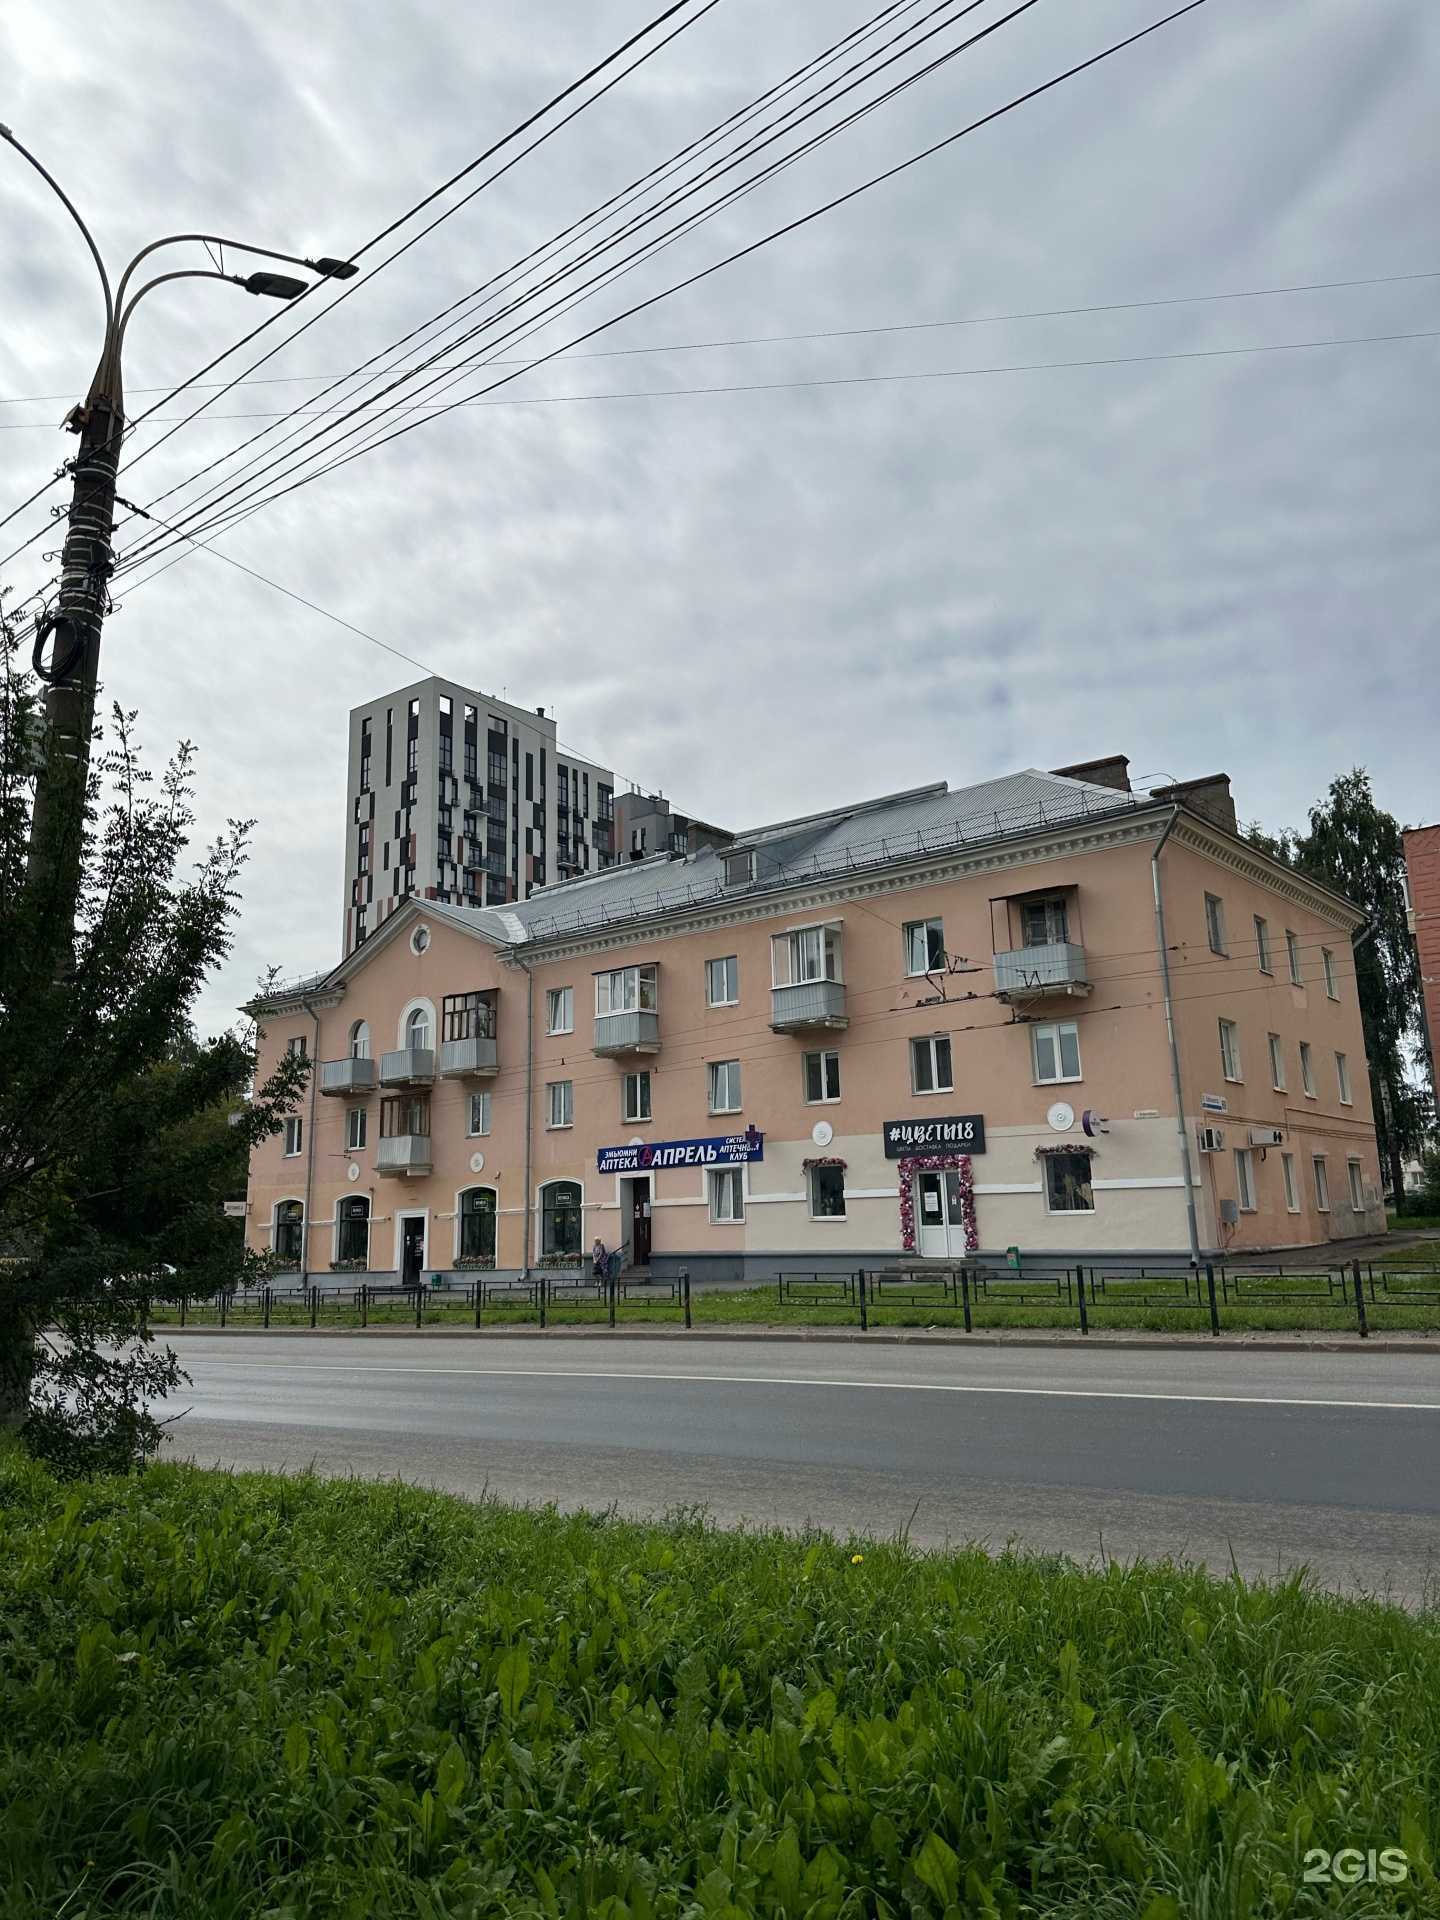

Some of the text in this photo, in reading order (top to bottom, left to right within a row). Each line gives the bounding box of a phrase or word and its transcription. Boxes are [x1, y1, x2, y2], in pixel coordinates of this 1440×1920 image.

[889, 1122, 974, 1145] #ЦВЕТЫ18
[600, 1157, 638, 1171] АПТЕКА
[651, 1145, 717, 1166] АПРЕЛЬ
[729, 1152, 748, 1161] КЛУБ
